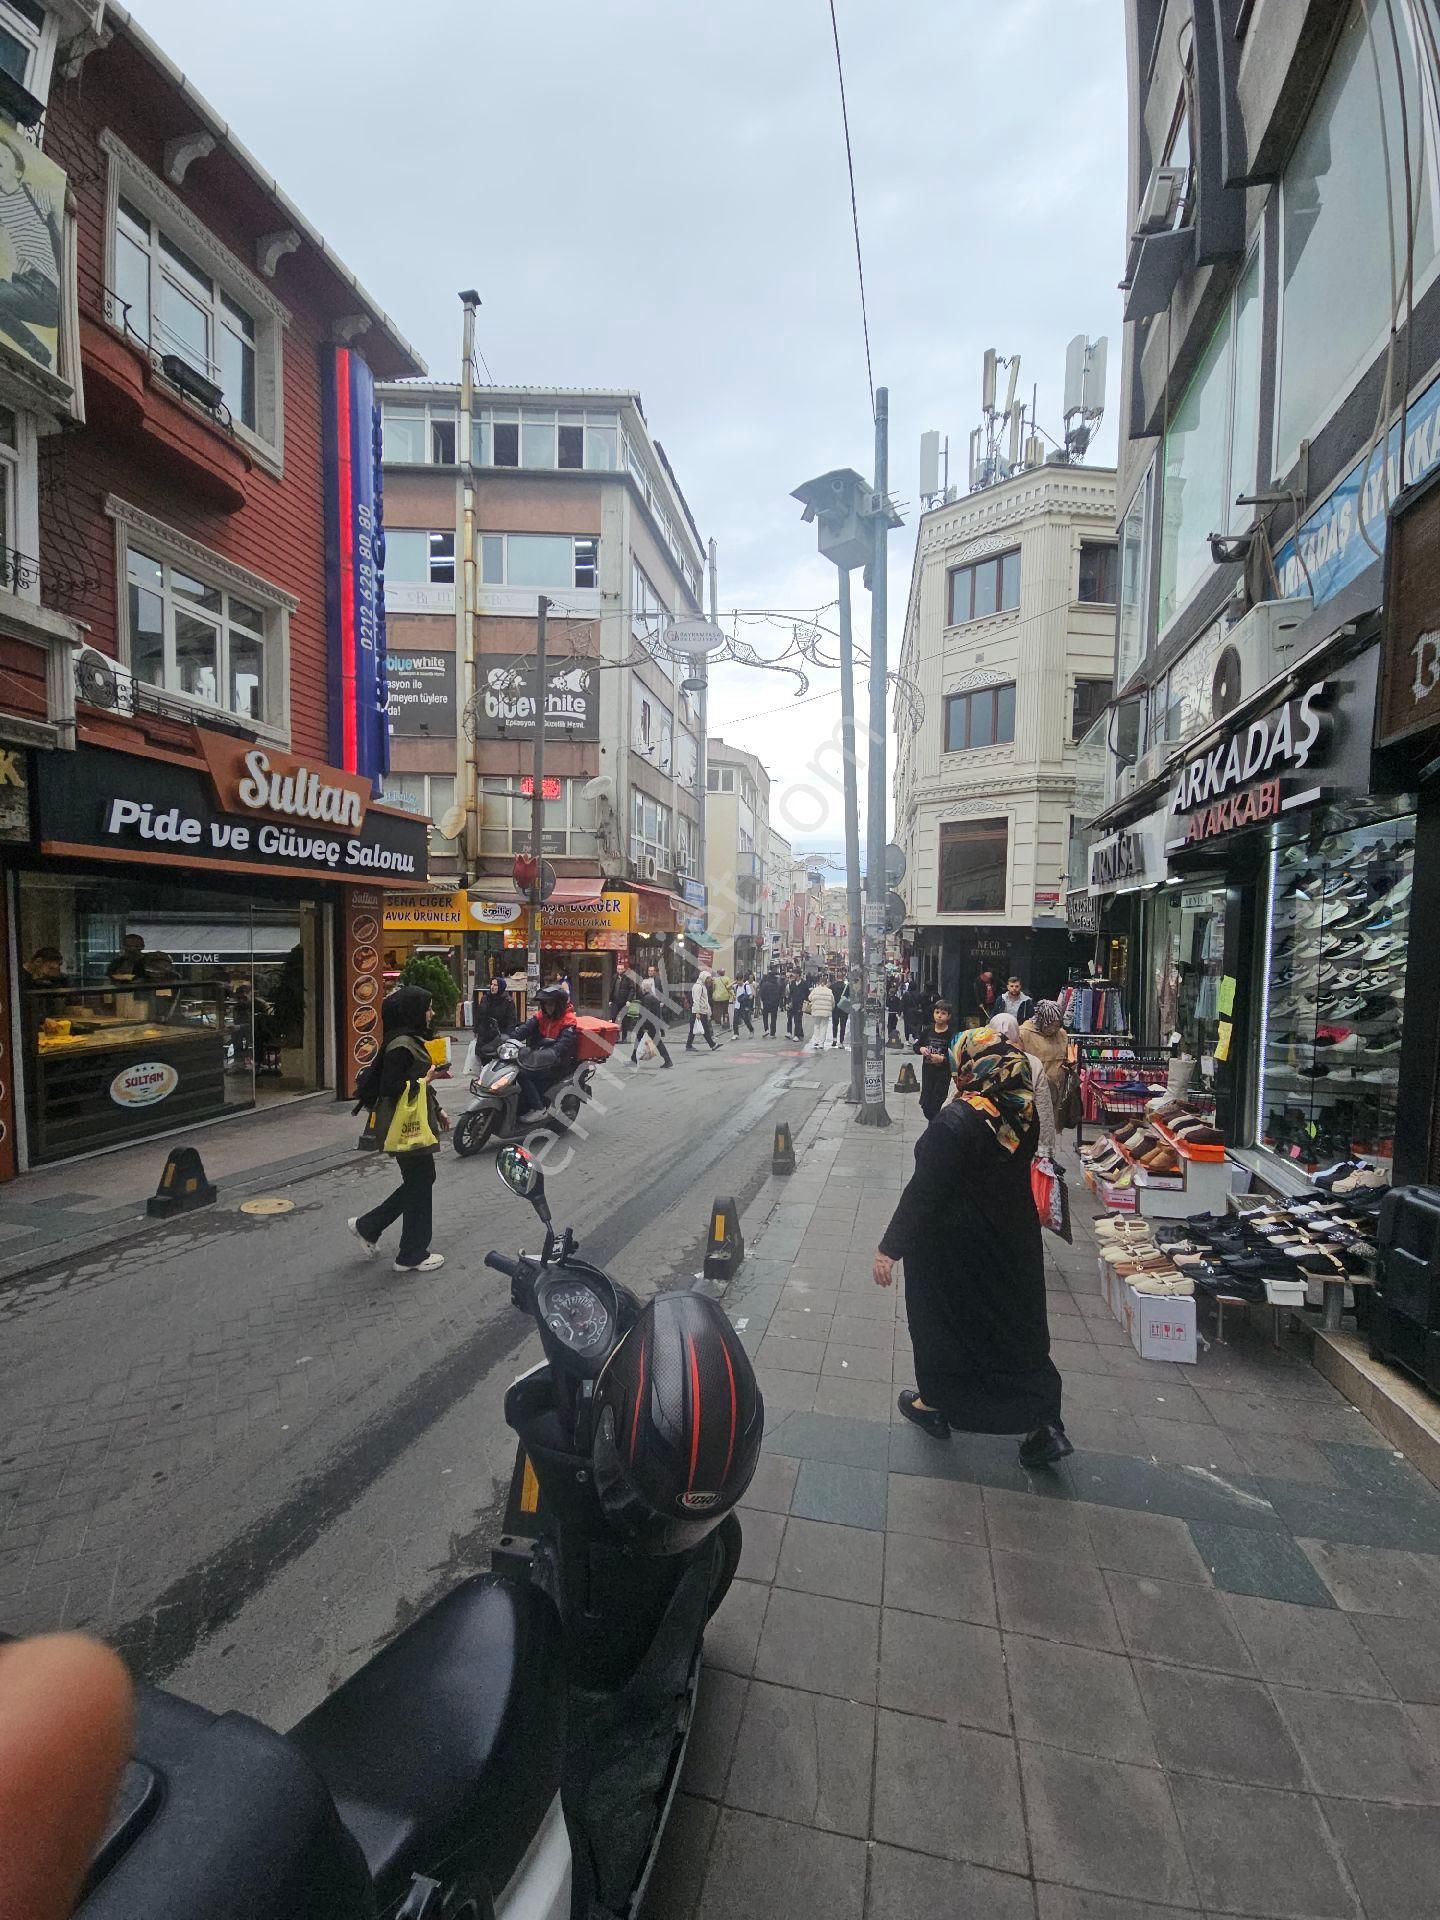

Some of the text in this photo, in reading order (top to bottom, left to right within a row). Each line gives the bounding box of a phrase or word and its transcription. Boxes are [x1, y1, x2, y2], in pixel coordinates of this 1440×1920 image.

[358, 503, 372, 650] 0212 628 80 80
[412, 679, 423, 689] ile
[420, 693, 448, 704] tüylere
[1171, 681, 1325, 814] ARKADAŞ
[238, 750, 363, 828] Sultan
[1185, 777, 1280, 843] AYAKKABI
[108, 799, 415, 873] Pide ve Güveç Salonu
[414, 910, 461, 923] ÜRÜNLERİ
[183, 954, 220, 963] HOME
[125, 1072, 164, 1088] SULTAN
